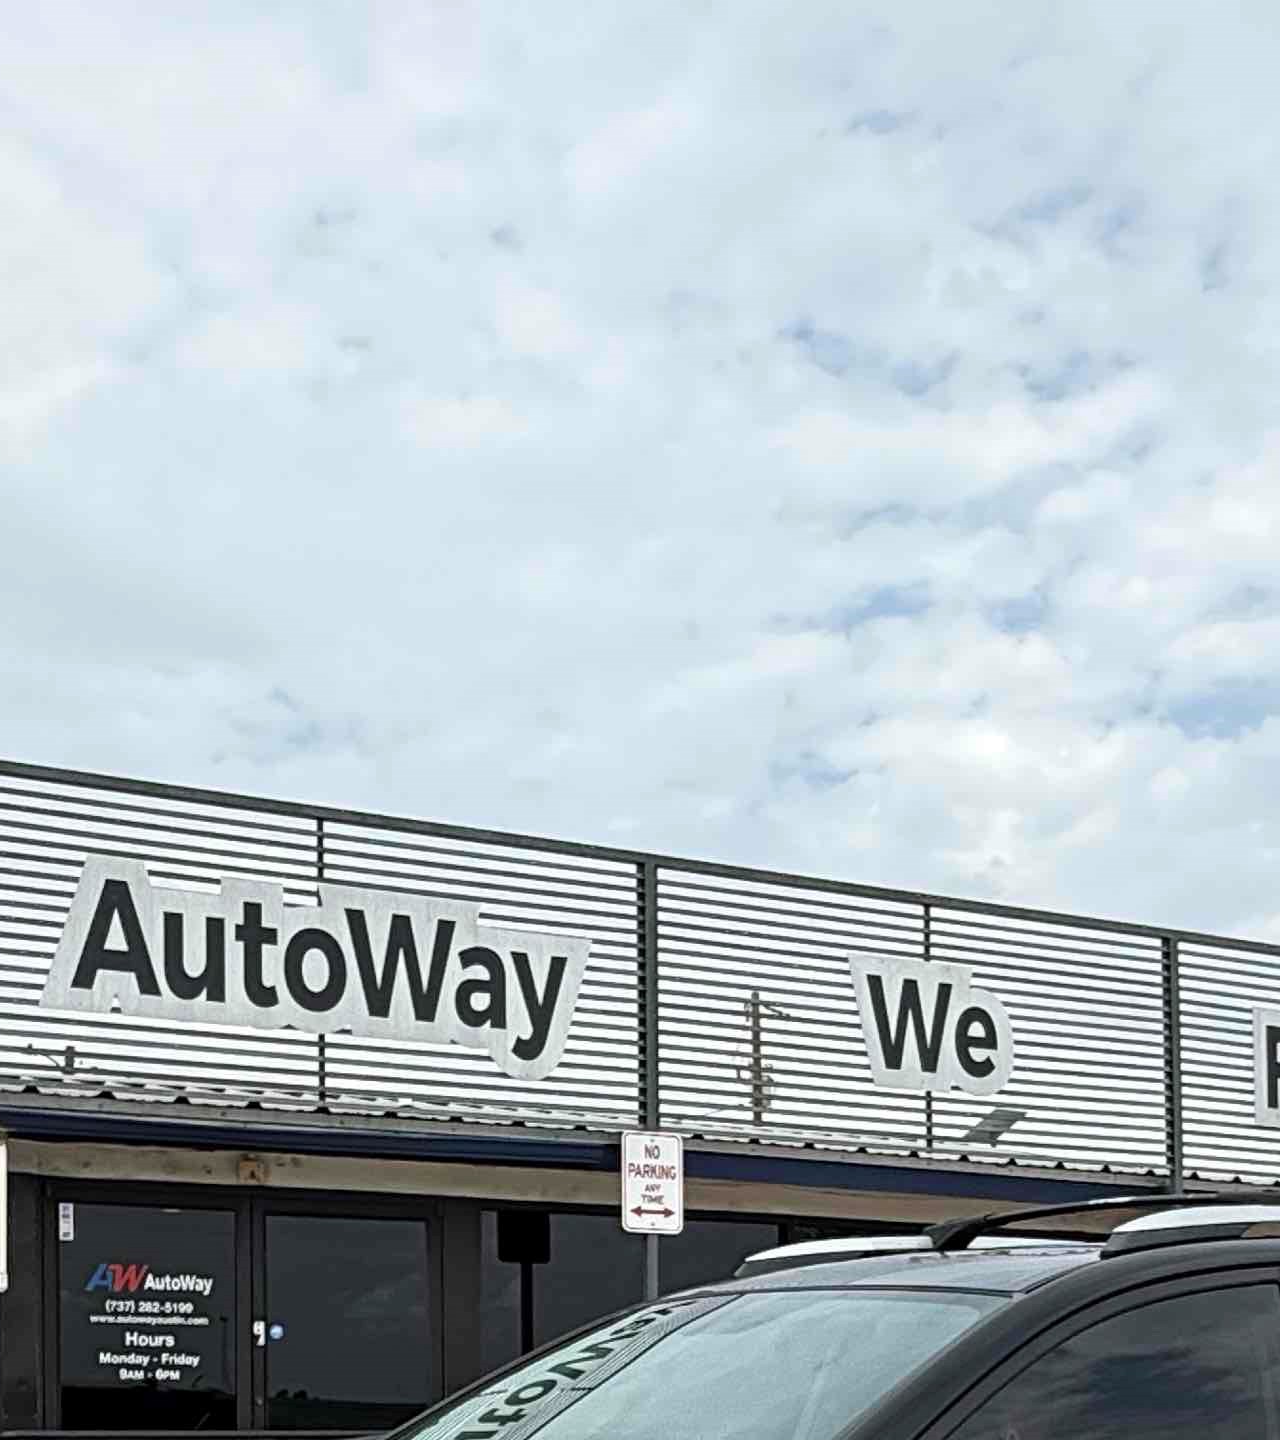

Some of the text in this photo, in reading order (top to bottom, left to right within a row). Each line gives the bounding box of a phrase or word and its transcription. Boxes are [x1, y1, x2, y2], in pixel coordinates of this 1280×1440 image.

[72, 879, 566, 1062] AutoWay
[866, 974, 999, 1078] We
[644, 1144, 660, 1160] NO
[628, 1163, 677, 1180] PARKING
[644, 1184, 662, 1193] ANY
[641, 1194, 665, 1205] TIME
[85, 1263, 214, 1296] AW AutoWay
[105, 1299, 135, 1314] (737)
[125, 1331, 176, 1347] Hours
[99, 1352, 150, 1367] Monday
[160, 1353, 200, 1368] Friday
